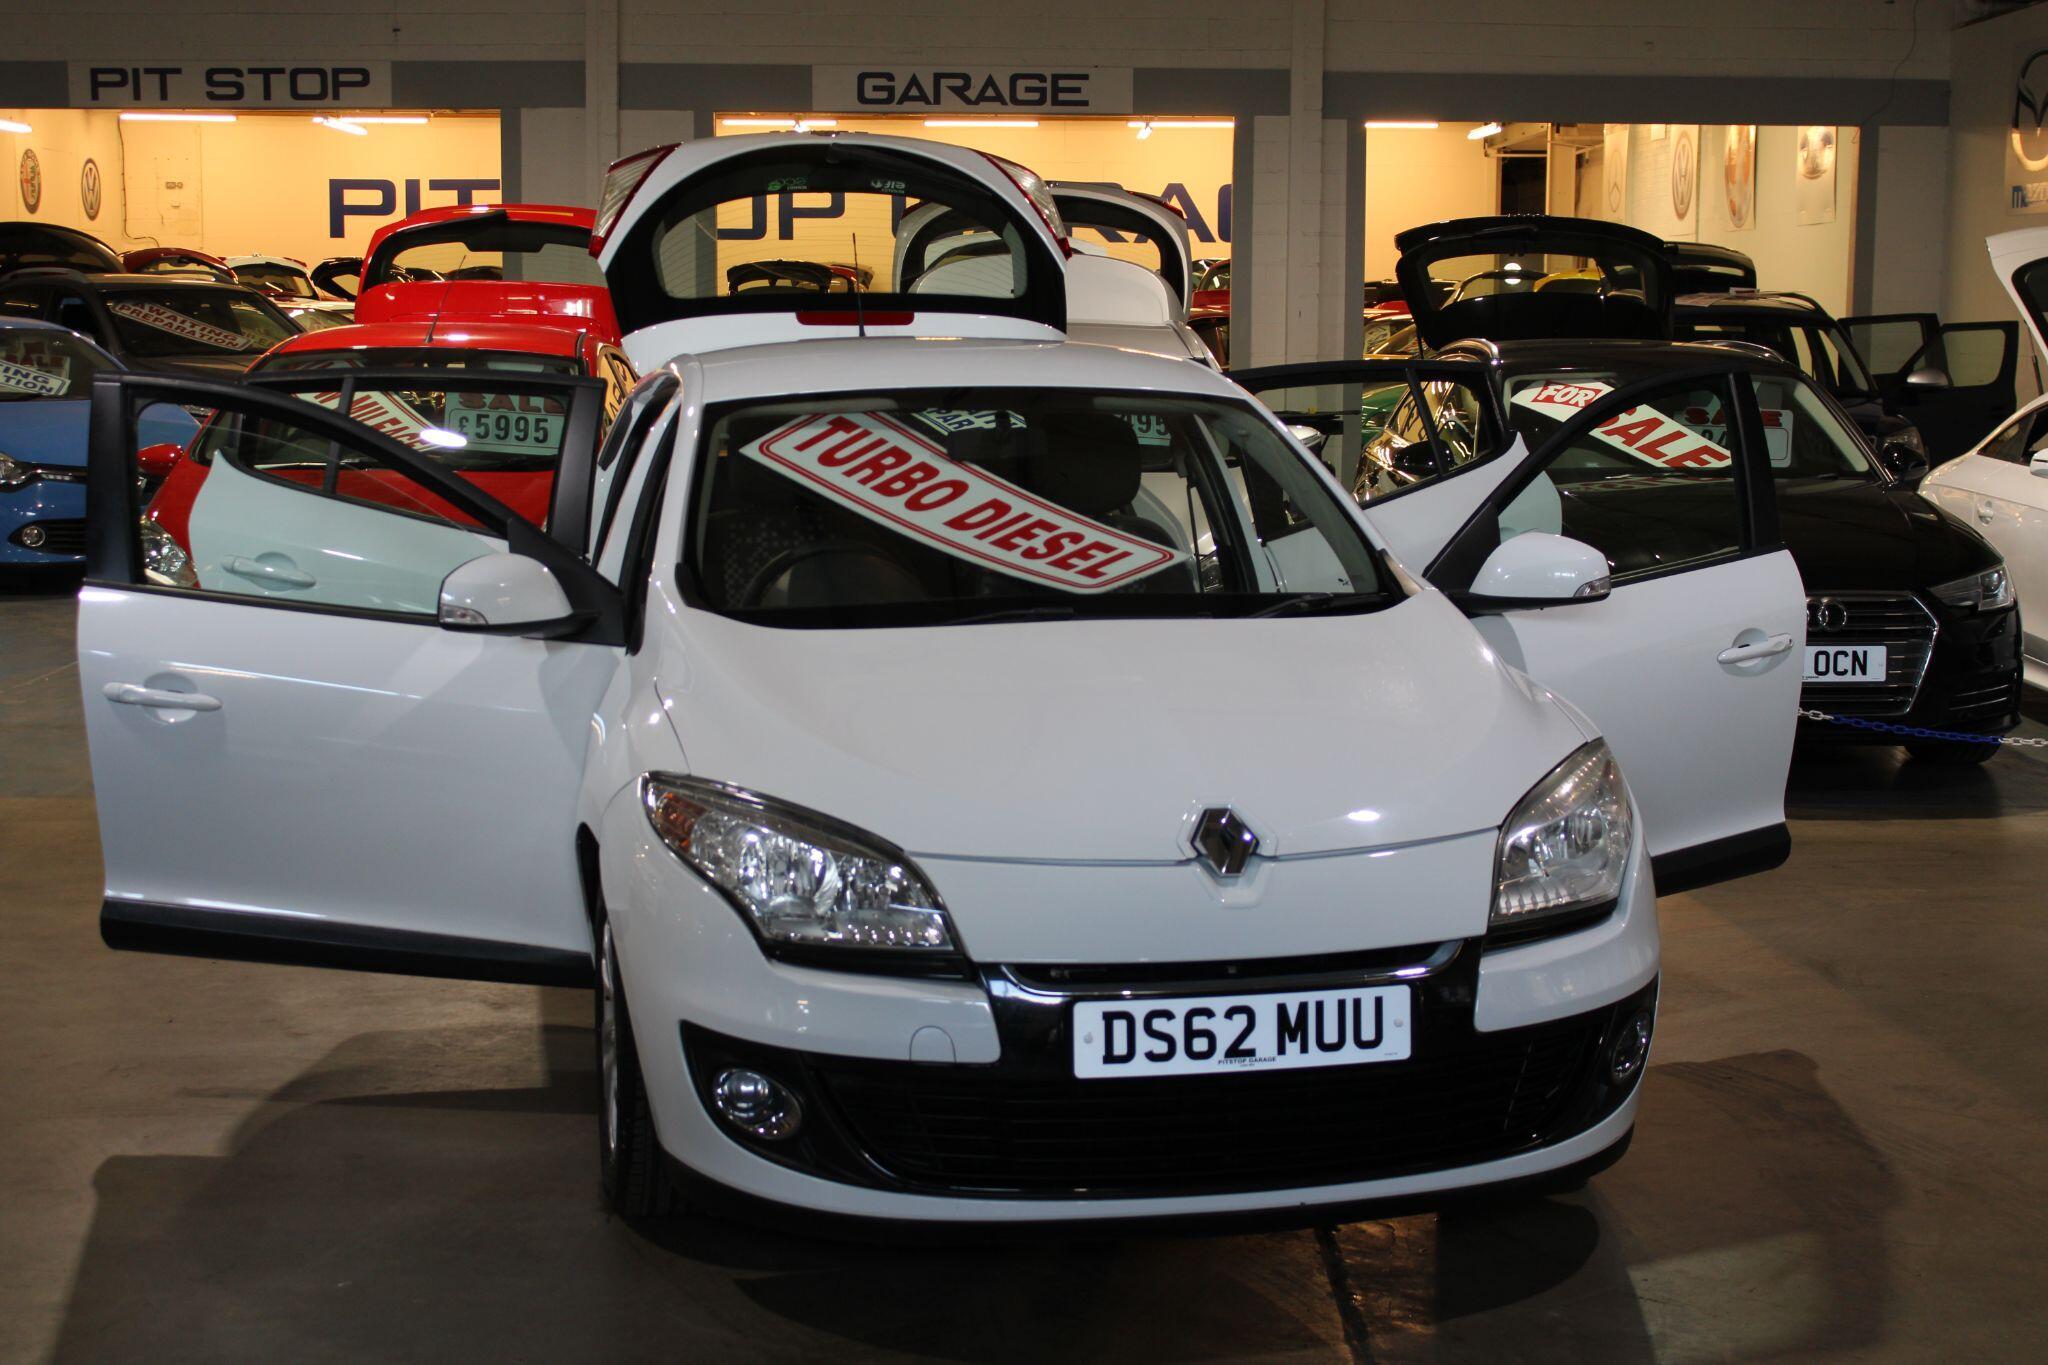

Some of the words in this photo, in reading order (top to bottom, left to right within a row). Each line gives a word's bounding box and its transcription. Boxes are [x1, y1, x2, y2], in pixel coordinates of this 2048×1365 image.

[90, 67, 182, 101] PIT
[206, 67, 371, 101] STOP
[857, 71, 1090, 106] GARAGE
[118, 304, 240, 348] PREPARATION
[134, 301, 238, 342] AWAITING
[1538, 384, 1597, 407] FOR
[1685, 407, 1783, 427] SAE
[793, 416, 970, 512] TURBO
[942, 498, 1135, 579] DIESEL
[1813, 650, 1868, 676] OCN
[1102, 1005, 1257, 1064] DS62
[1277, 995, 1384, 1056] MUU
